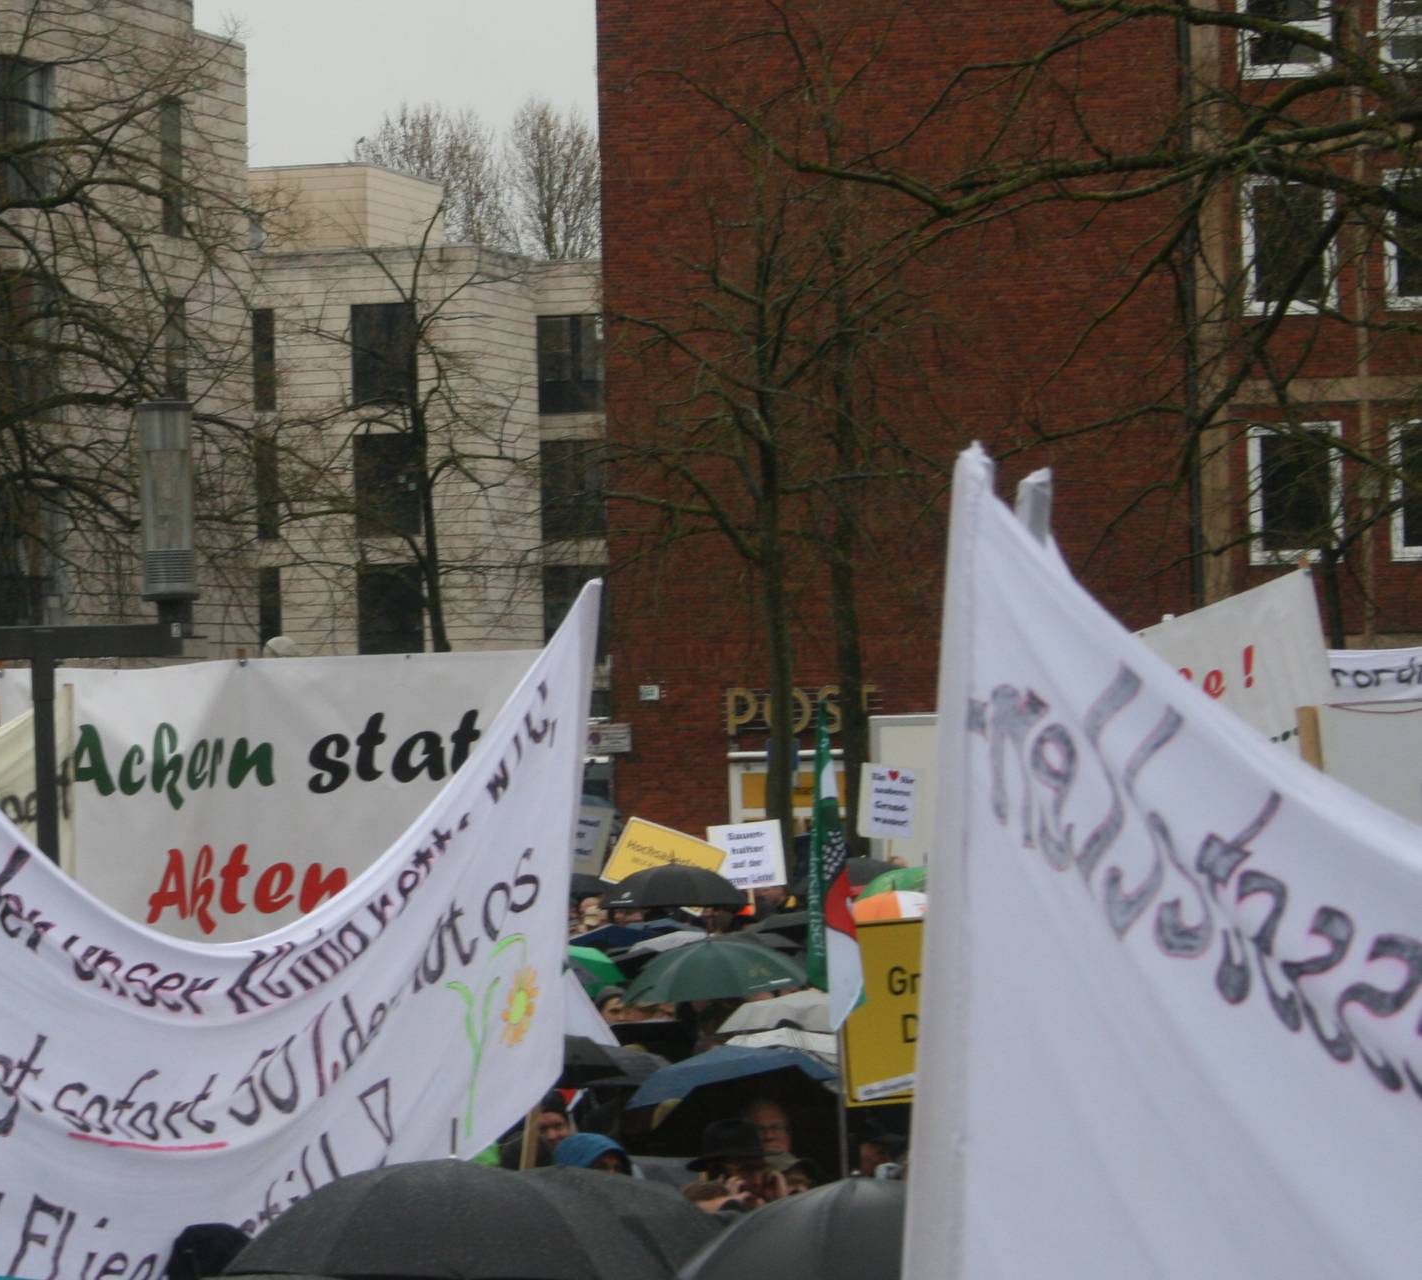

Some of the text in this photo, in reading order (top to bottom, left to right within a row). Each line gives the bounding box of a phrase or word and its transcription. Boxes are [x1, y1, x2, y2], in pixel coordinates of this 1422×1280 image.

[74, 722, 275, 810] Ackern
[146, 843, 349, 935] Akten
[64, 934, 219, 1016] unser
[53, 1069, 218, 1140] sofort
